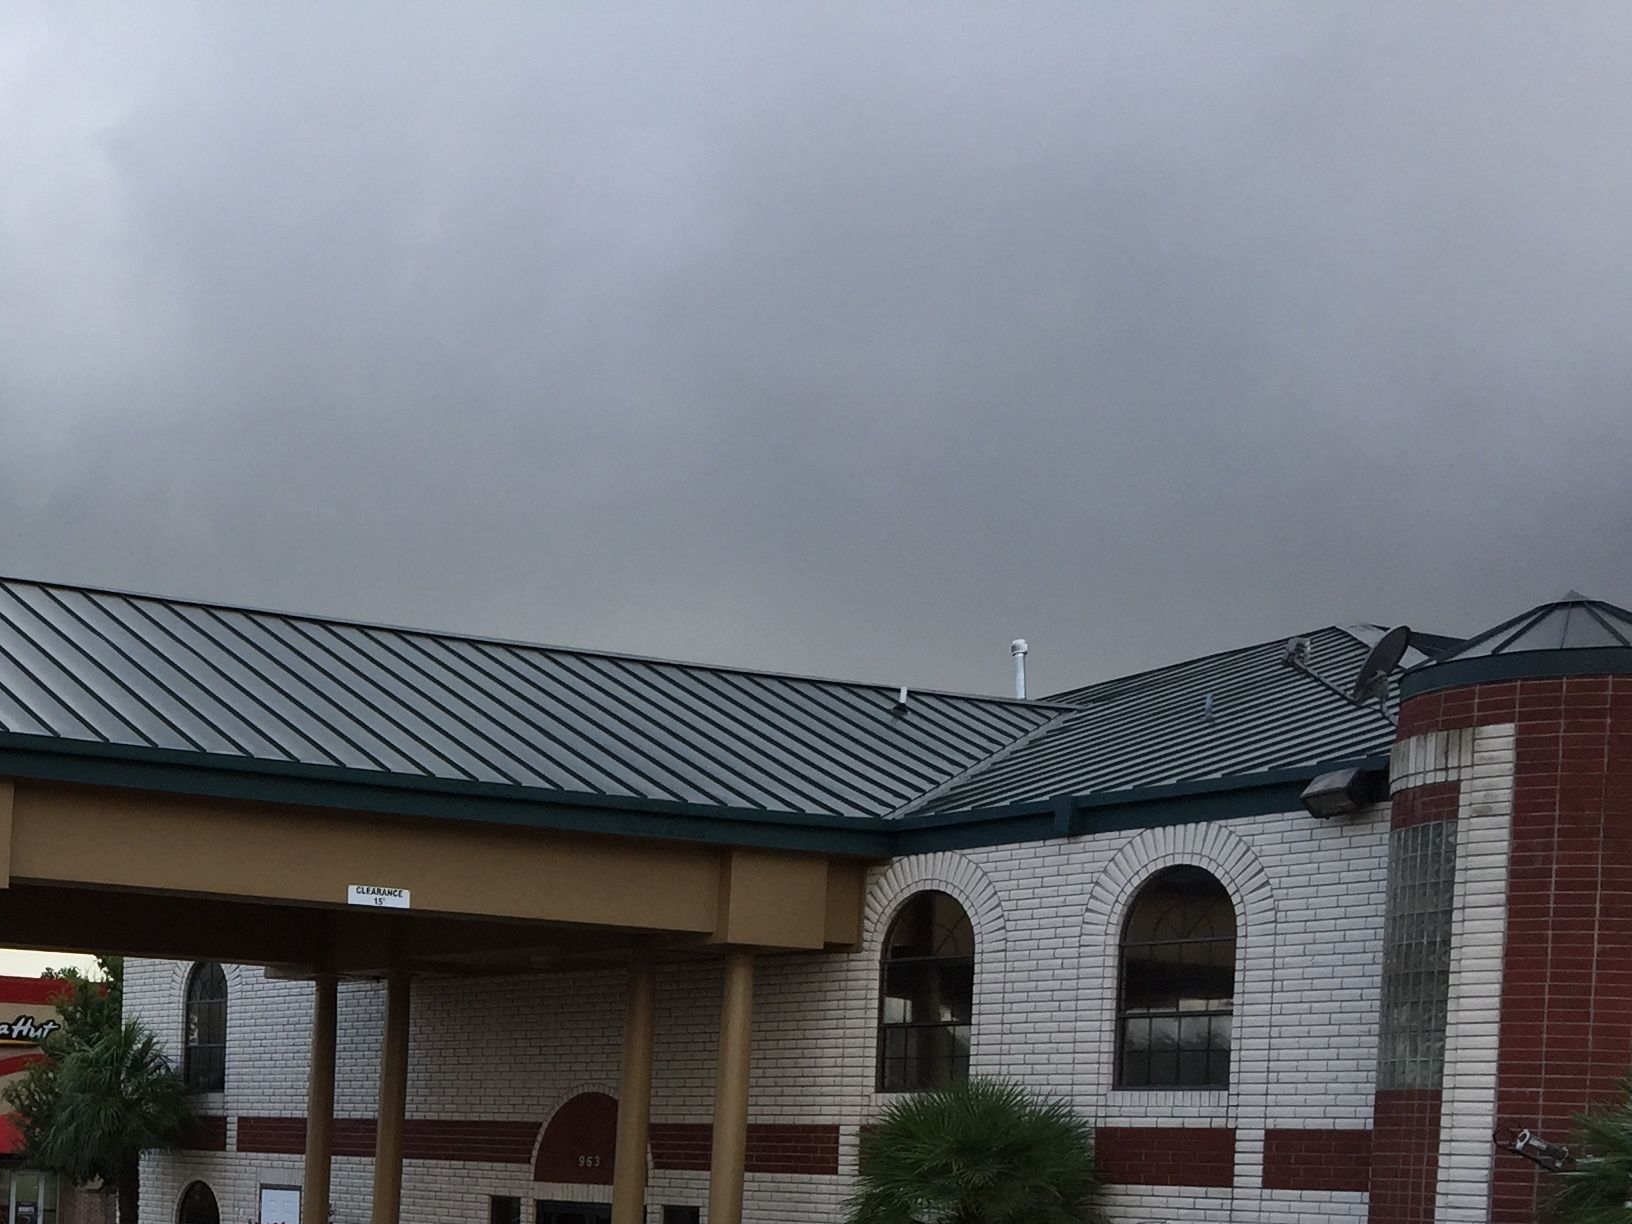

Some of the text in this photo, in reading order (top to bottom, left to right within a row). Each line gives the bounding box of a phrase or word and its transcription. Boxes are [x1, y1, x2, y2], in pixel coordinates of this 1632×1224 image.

[356, 887, 403, 897] CLEARANCE
[11, 1017, 60, 1039] Hut
[578, 1155, 600, 1167] 963
